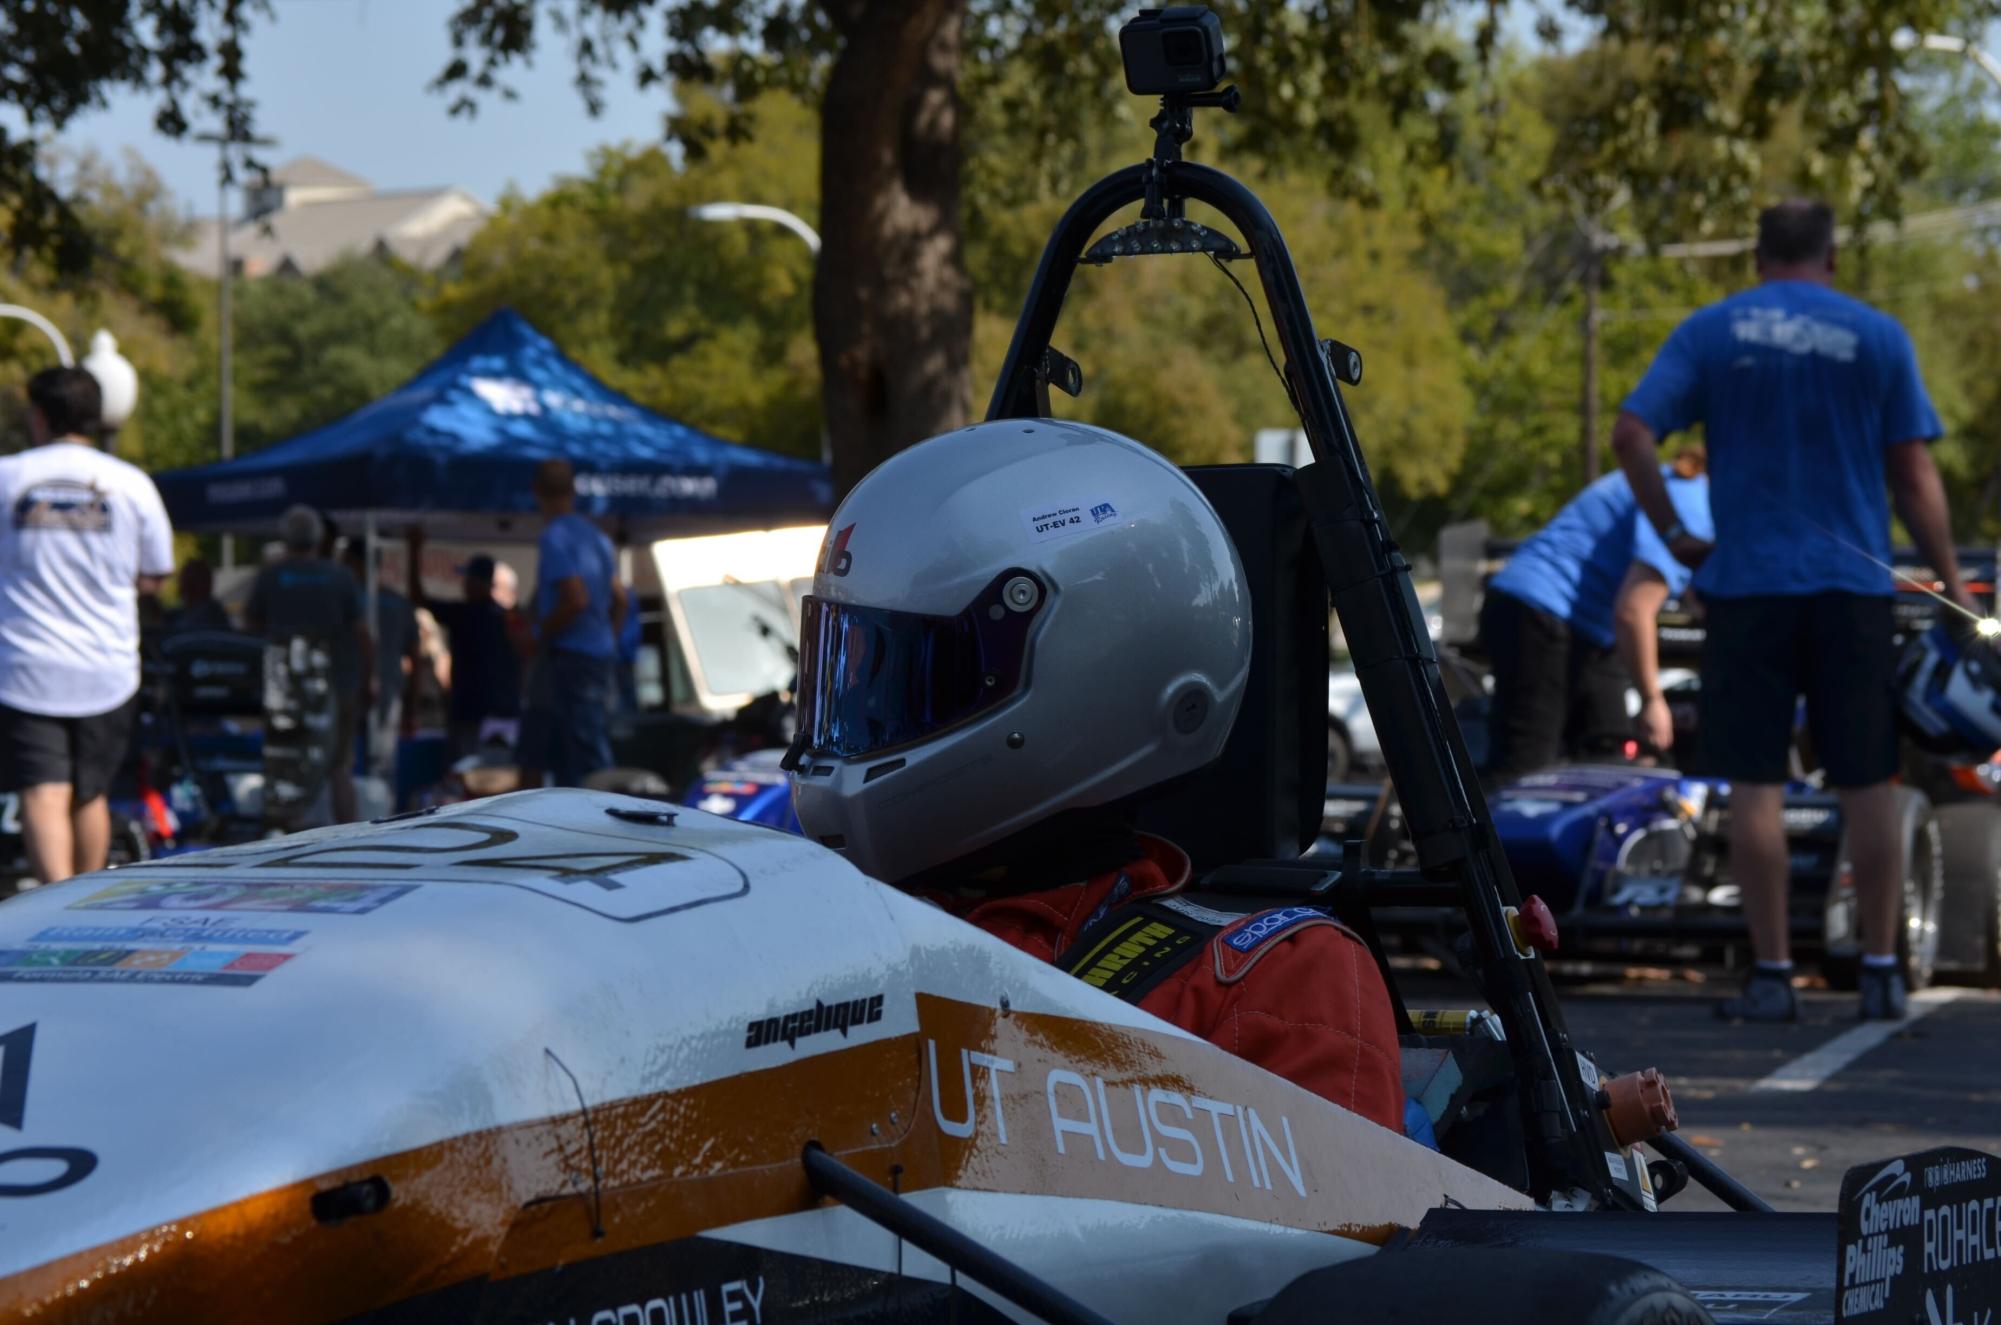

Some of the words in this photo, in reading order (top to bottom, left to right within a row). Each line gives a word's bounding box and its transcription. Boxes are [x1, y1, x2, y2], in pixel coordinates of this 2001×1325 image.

[1035, 519, 1066, 533] UT-EV
[1069, 515, 1082, 525] 42
[928, 1038, 1016, 1146] UT
[1046, 1067, 1307, 1198] AUSTIN
[1860, 1190, 1920, 1236] Chevron
[1843, 1233, 1904, 1299] Phillips
[1842, 1281, 1885, 1319] CHEMICAL
